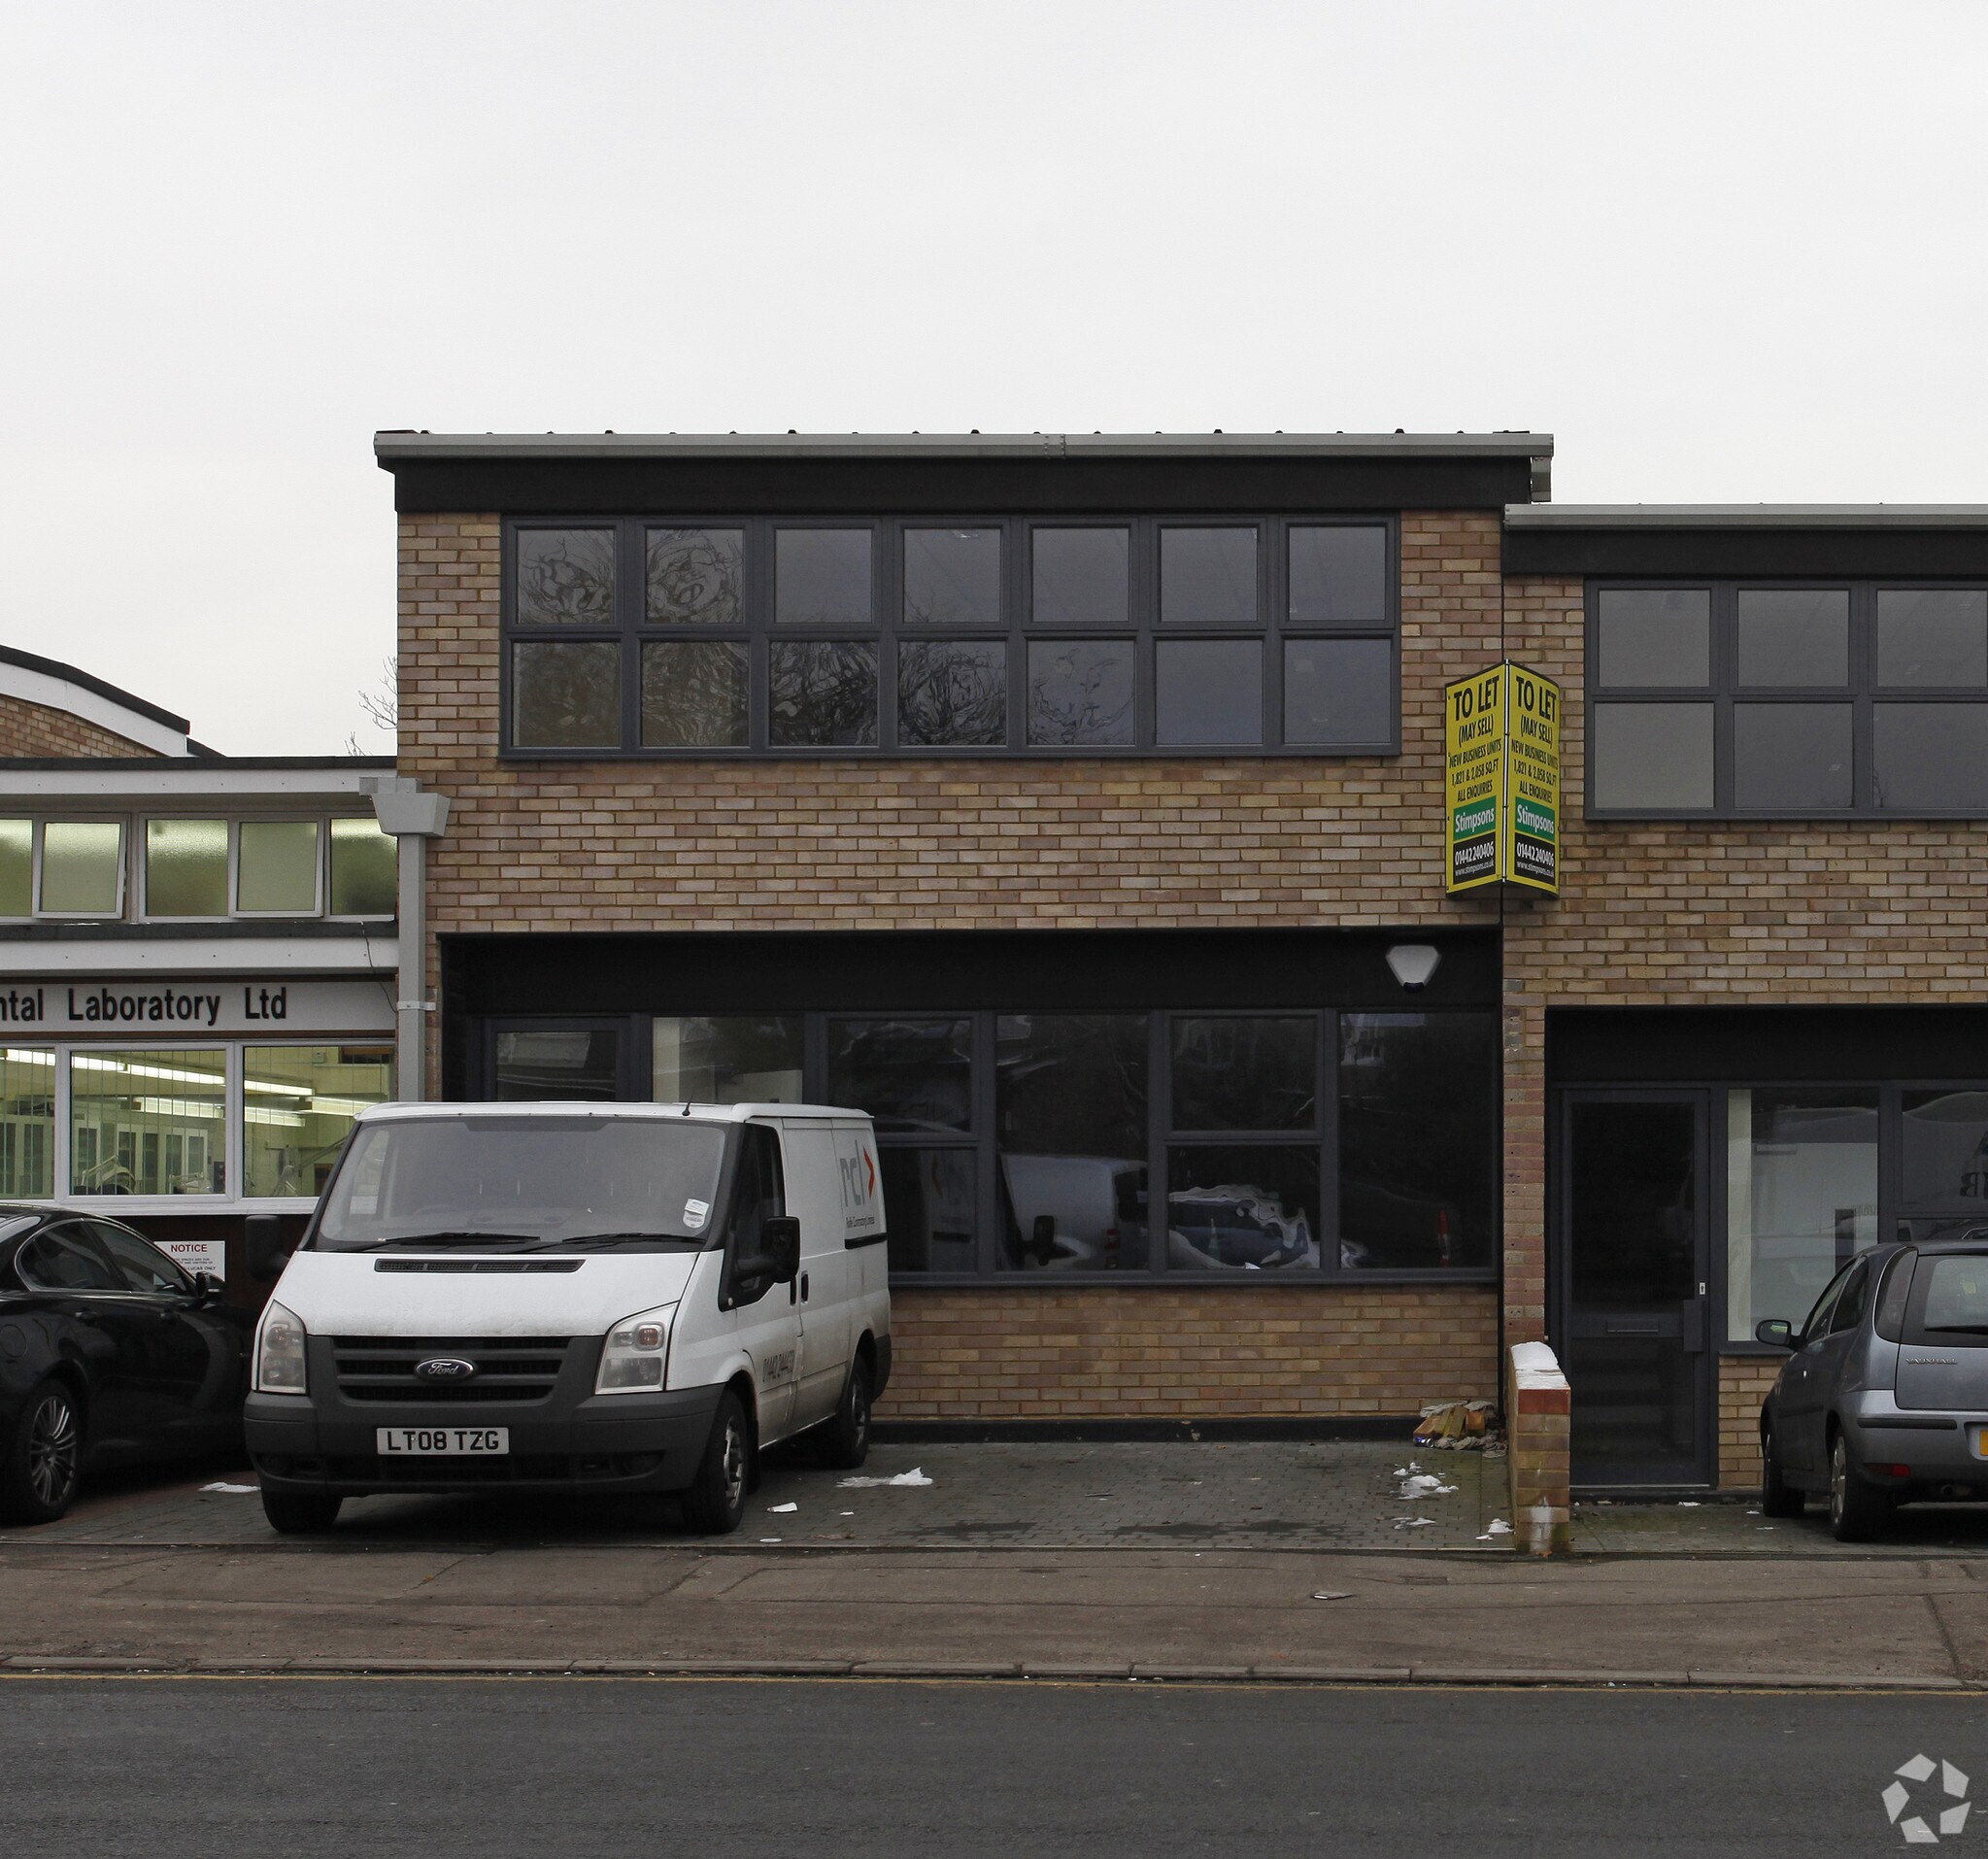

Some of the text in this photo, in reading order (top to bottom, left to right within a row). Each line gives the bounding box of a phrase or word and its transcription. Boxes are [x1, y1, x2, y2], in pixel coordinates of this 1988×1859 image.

[1454, 675, 1499, 721] TO LET
[1516, 676, 1556, 723] TO LET
[1459, 714, 1494, 748] (MAY SELL)
[1521, 715, 1553, 750] (MAY SELL)
[1449, 739, 1501, 768] NEW BUSINESS UNITS
[1511, 739, 1524, 755] NEW
[1525, 744, 1547, 764] BUSINESS
[1467, 779, 1493, 799] ENQUIRIES
[1519, 781, 1553, 804] ALL ENQUIRIES
[1455, 808, 1495, 832] Stimpsons
[1517, 804, 1554, 834] Stimpsons
[68, 988, 221, 1026] Laboratory
[245, 987, 286, 1019] Ltd
[428, 1362, 459, 1374] Ford
[387, 1431, 499, 1450] LT08 TZG
